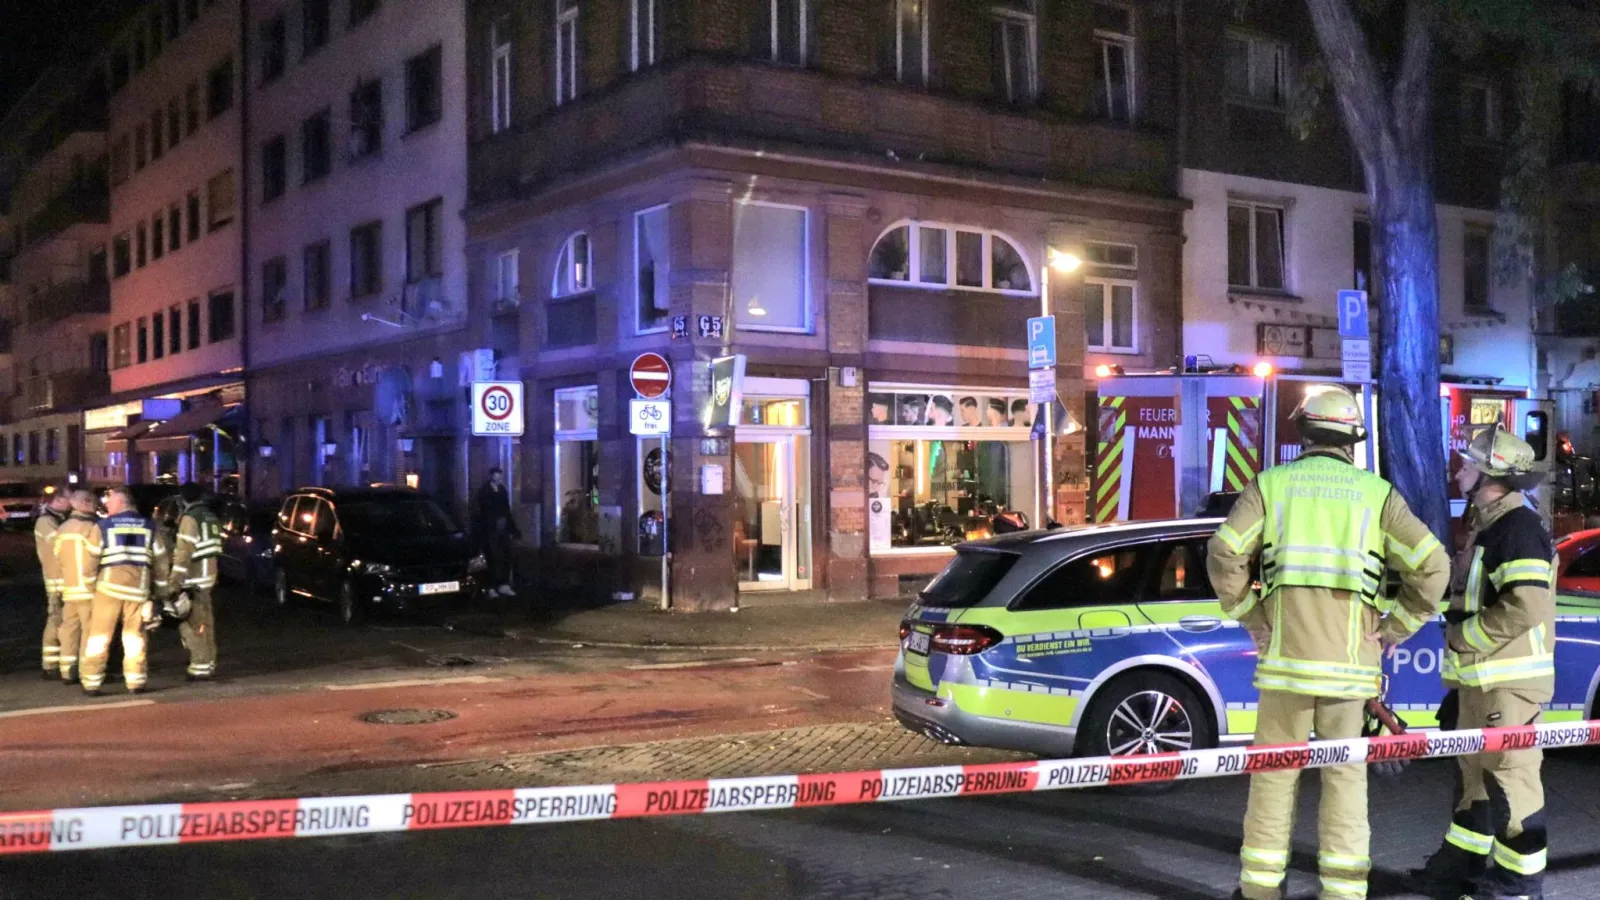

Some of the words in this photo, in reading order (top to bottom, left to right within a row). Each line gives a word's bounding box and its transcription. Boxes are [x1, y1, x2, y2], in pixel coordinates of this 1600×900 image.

[1344, 296, 1361, 331] P
[1032, 321, 1043, 341] P
[487, 395, 507, 411] 30
[1139, 408, 1211, 422] FEUERR
[485, 422, 510, 432] ZONE
[644, 421, 658, 430] frei
[1138, 425, 1212, 441] MANNM
[1288, 473, 1354, 486] MANNHEIM
[1027, 641, 1062, 652] VERDIENST
[120, 804, 370, 840] POLIZEIABSPERRUNG
[402, 793, 618, 826] POLIZEIABSPERRUNG
[644, 780, 837, 812] POLIZEIABSPERRUNG
[860, 771, 1028, 799] POLIZEIABSPERRUNG
[1048, 757, 1198, 786] POLIZEIABSPERRUNG
[1215, 745, 1349, 773] POLIZEIABSPERRUNG
[1365, 734, 1487, 760] POLIZEIABSPERRUNG
